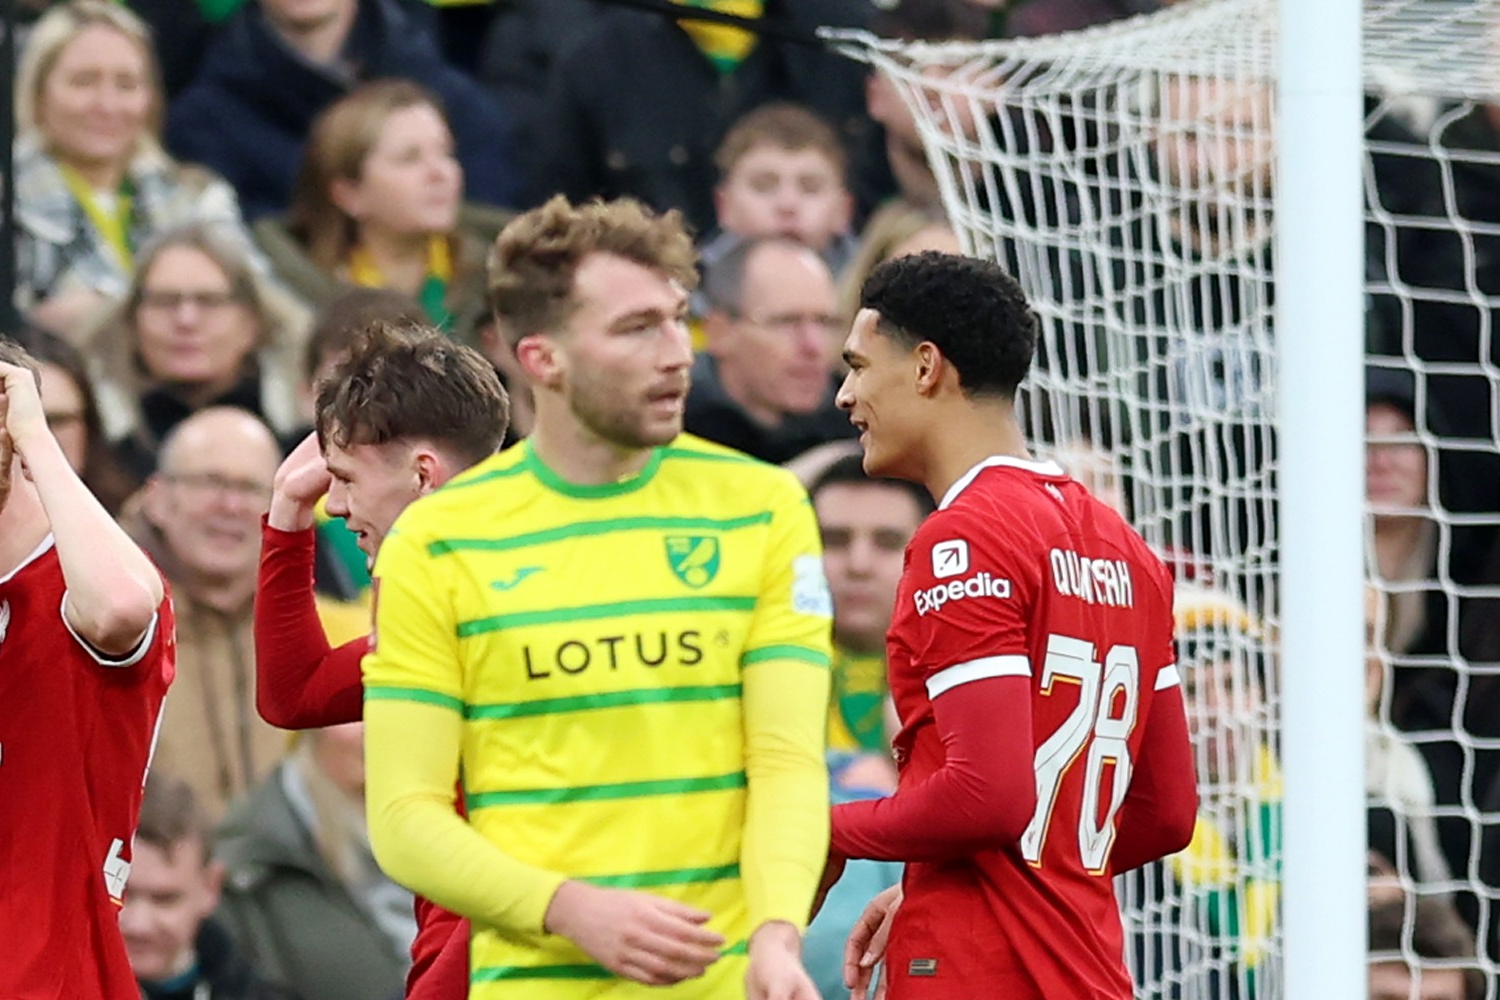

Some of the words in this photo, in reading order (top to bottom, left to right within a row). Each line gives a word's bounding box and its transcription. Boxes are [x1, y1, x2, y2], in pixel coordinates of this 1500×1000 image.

[912, 571, 1012, 617] Expedia
[523, 630, 705, 681] LOTUS
[1020, 633, 1140, 876] 78
